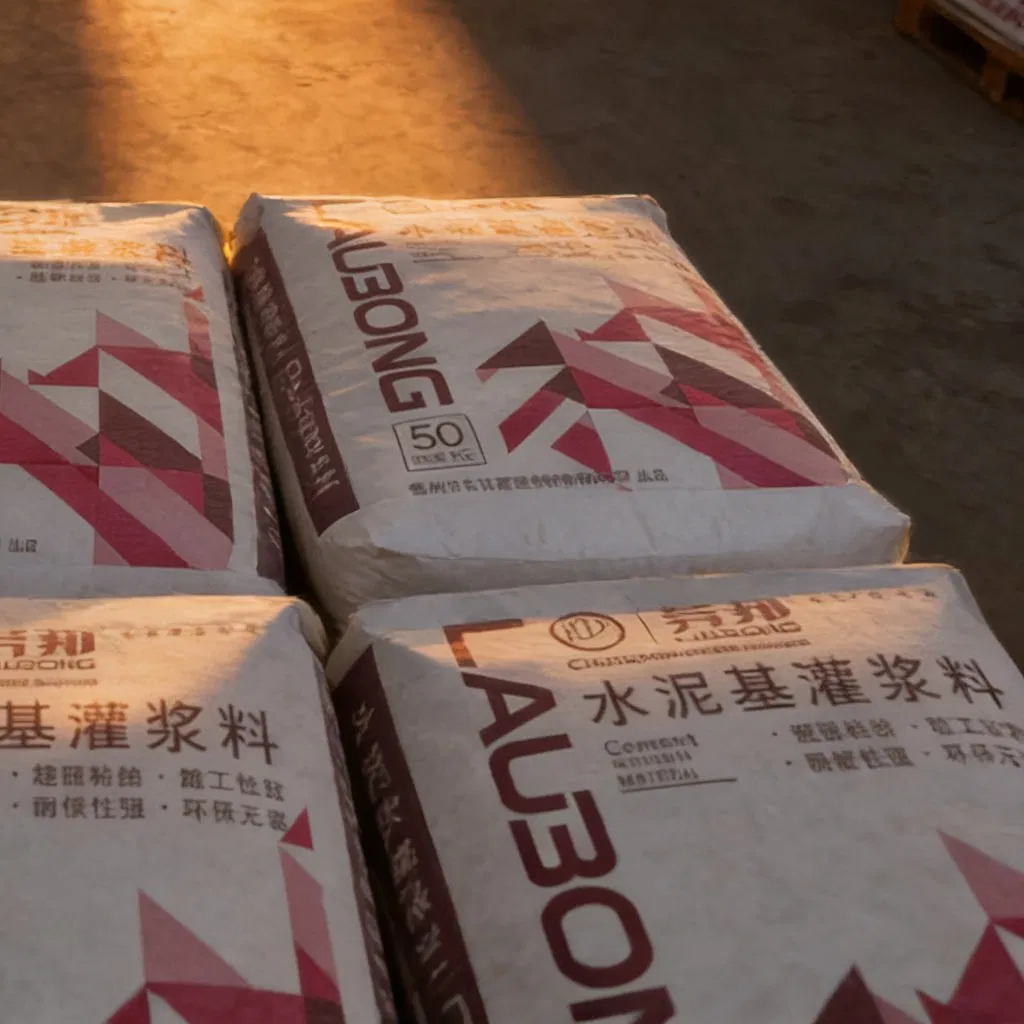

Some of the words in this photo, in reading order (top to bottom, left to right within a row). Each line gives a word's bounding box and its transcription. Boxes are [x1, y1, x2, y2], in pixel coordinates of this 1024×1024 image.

[411, 422, 464, 450] 50
[582, 653, 1006, 728] 水泥基灌浆料
